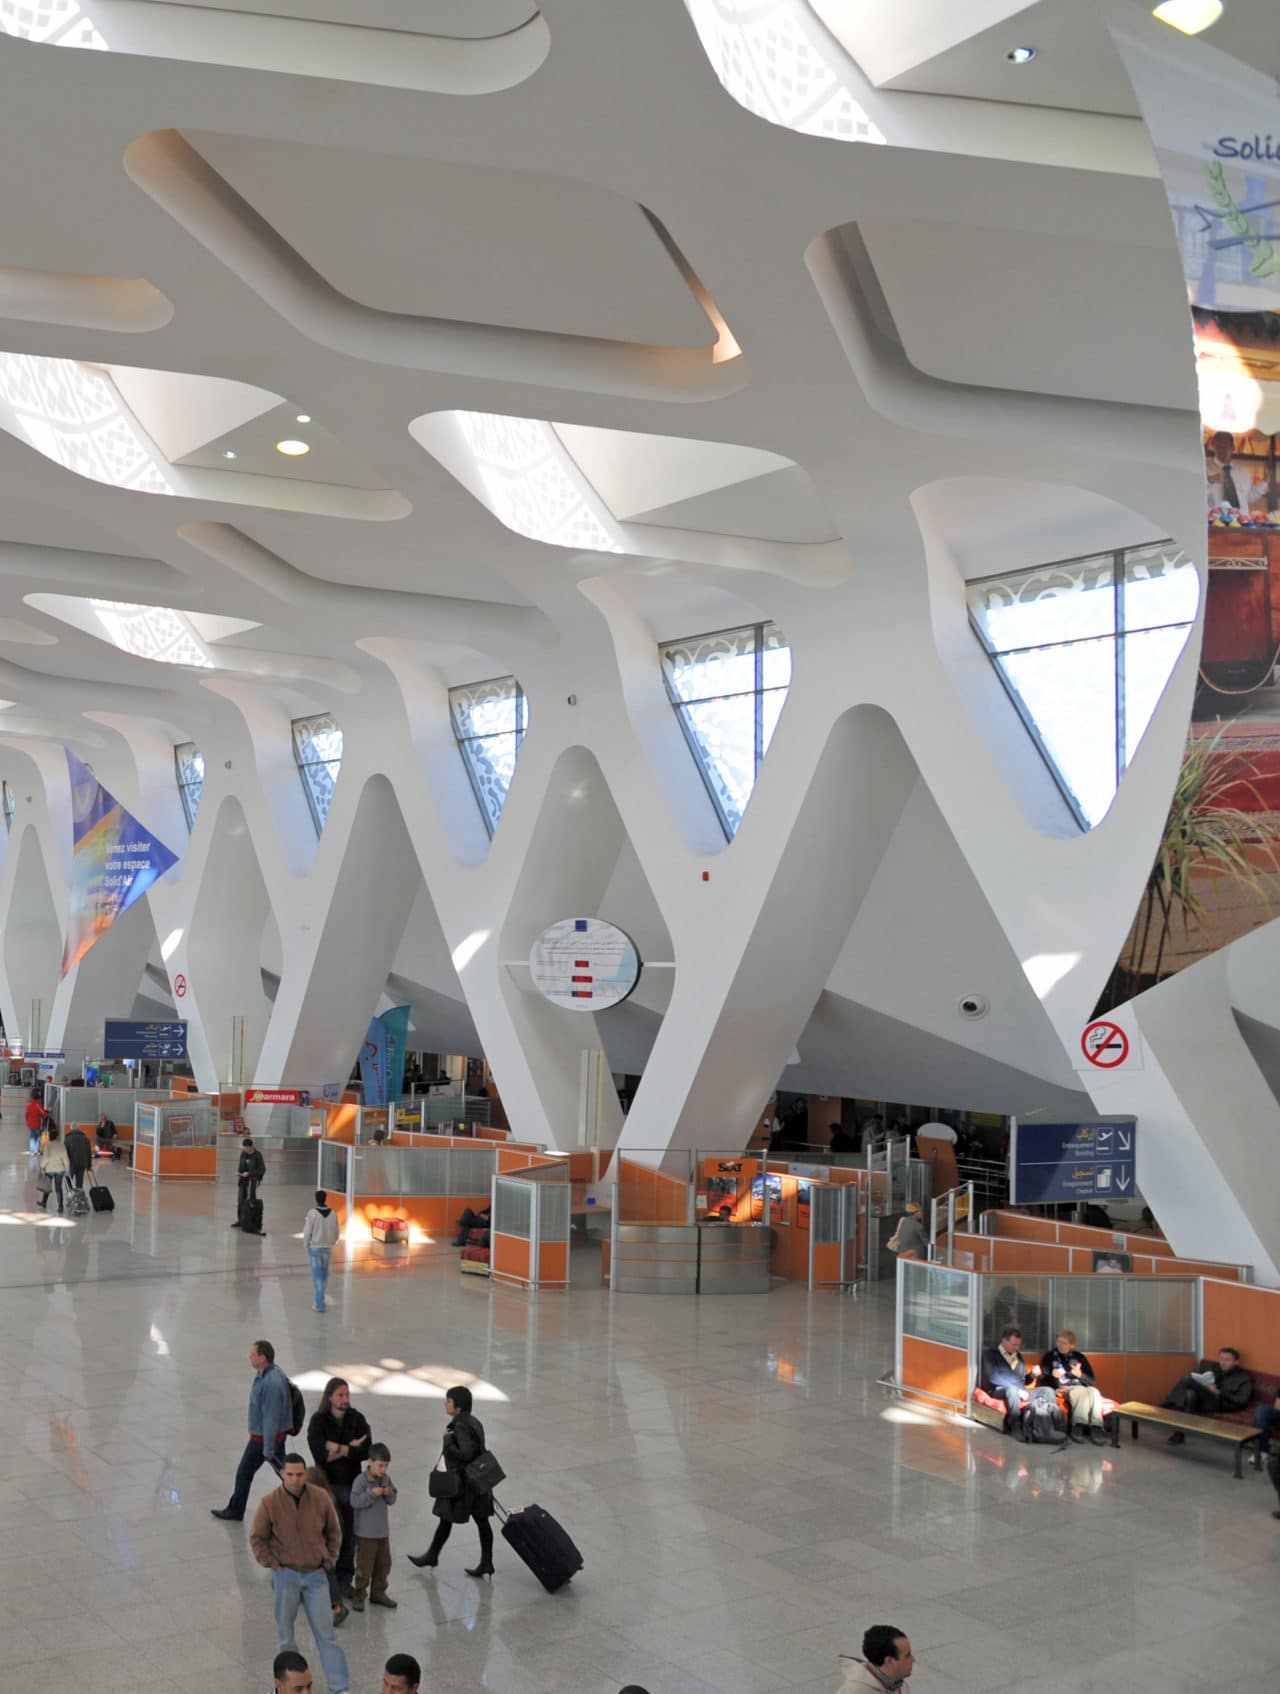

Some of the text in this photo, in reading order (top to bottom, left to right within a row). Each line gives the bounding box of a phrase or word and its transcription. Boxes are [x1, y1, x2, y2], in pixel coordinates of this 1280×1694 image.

[1213, 134, 1280, 160] Soli
[127, 841, 151, 852] visiter
[123, 861, 150, 872] espace
